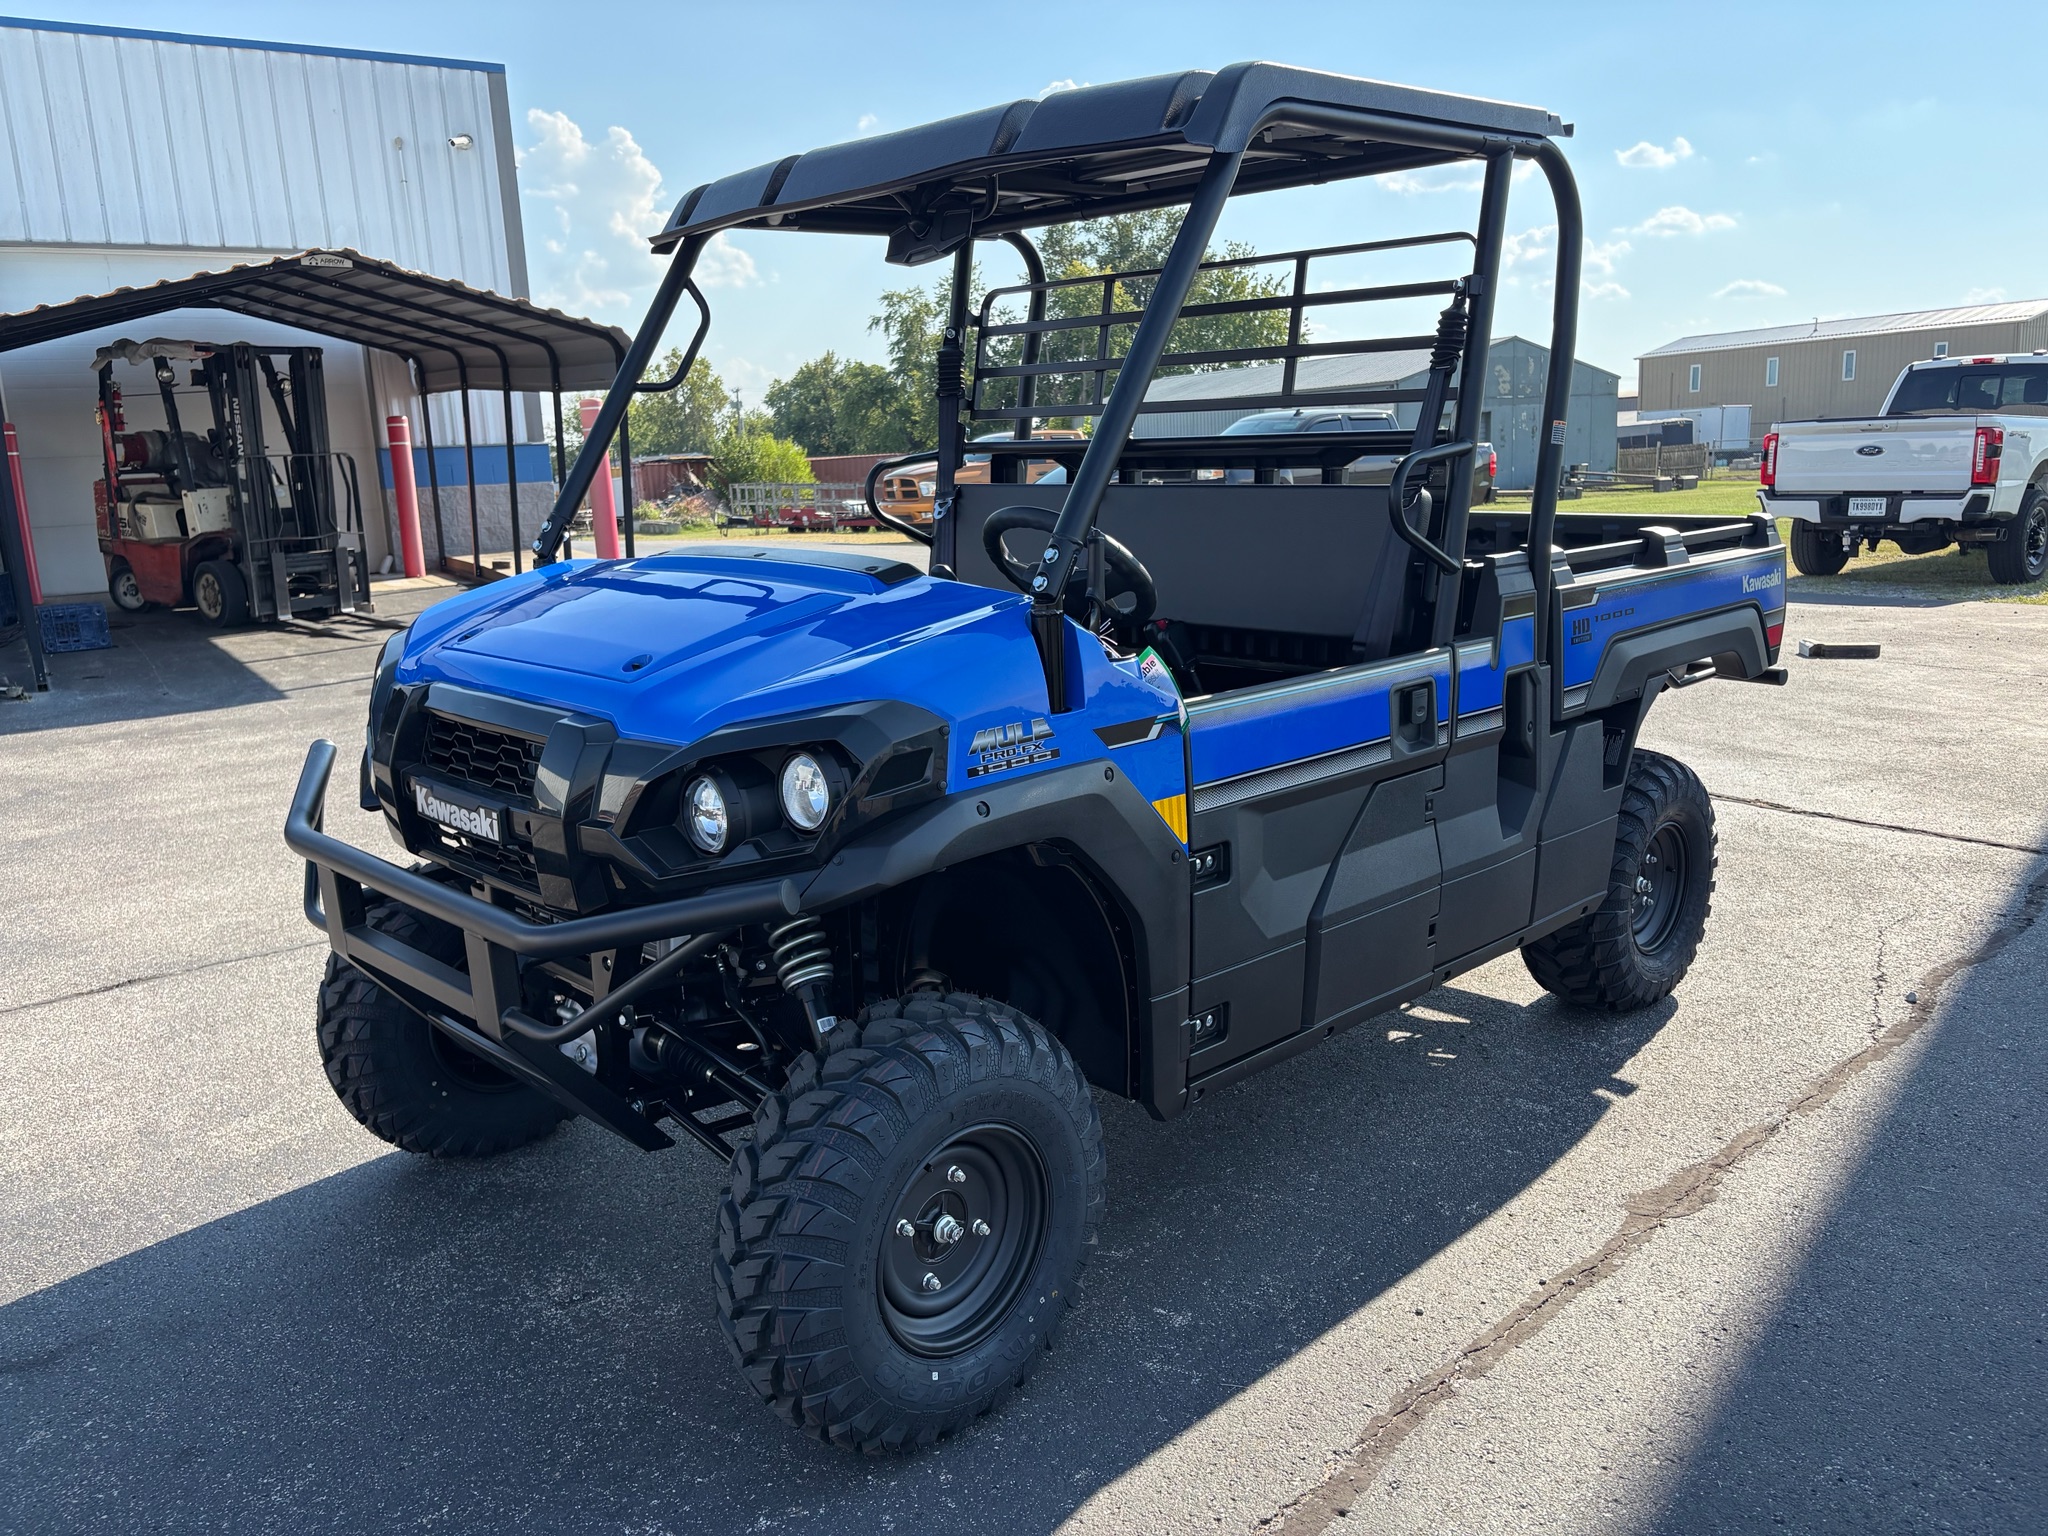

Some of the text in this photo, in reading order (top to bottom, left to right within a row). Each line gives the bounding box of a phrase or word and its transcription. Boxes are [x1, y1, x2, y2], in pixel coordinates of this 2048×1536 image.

[320, 257, 345, 265] ARROW
[232, 398, 244, 456] NISSAN
[1742, 567, 1781, 593] Kawasaki
[1573, 607, 1634, 635] HD 1000
[968, 717, 1056, 756] MULE
[976, 751, 1052, 775] 1000
[416, 784, 499, 841] Kawasaki
